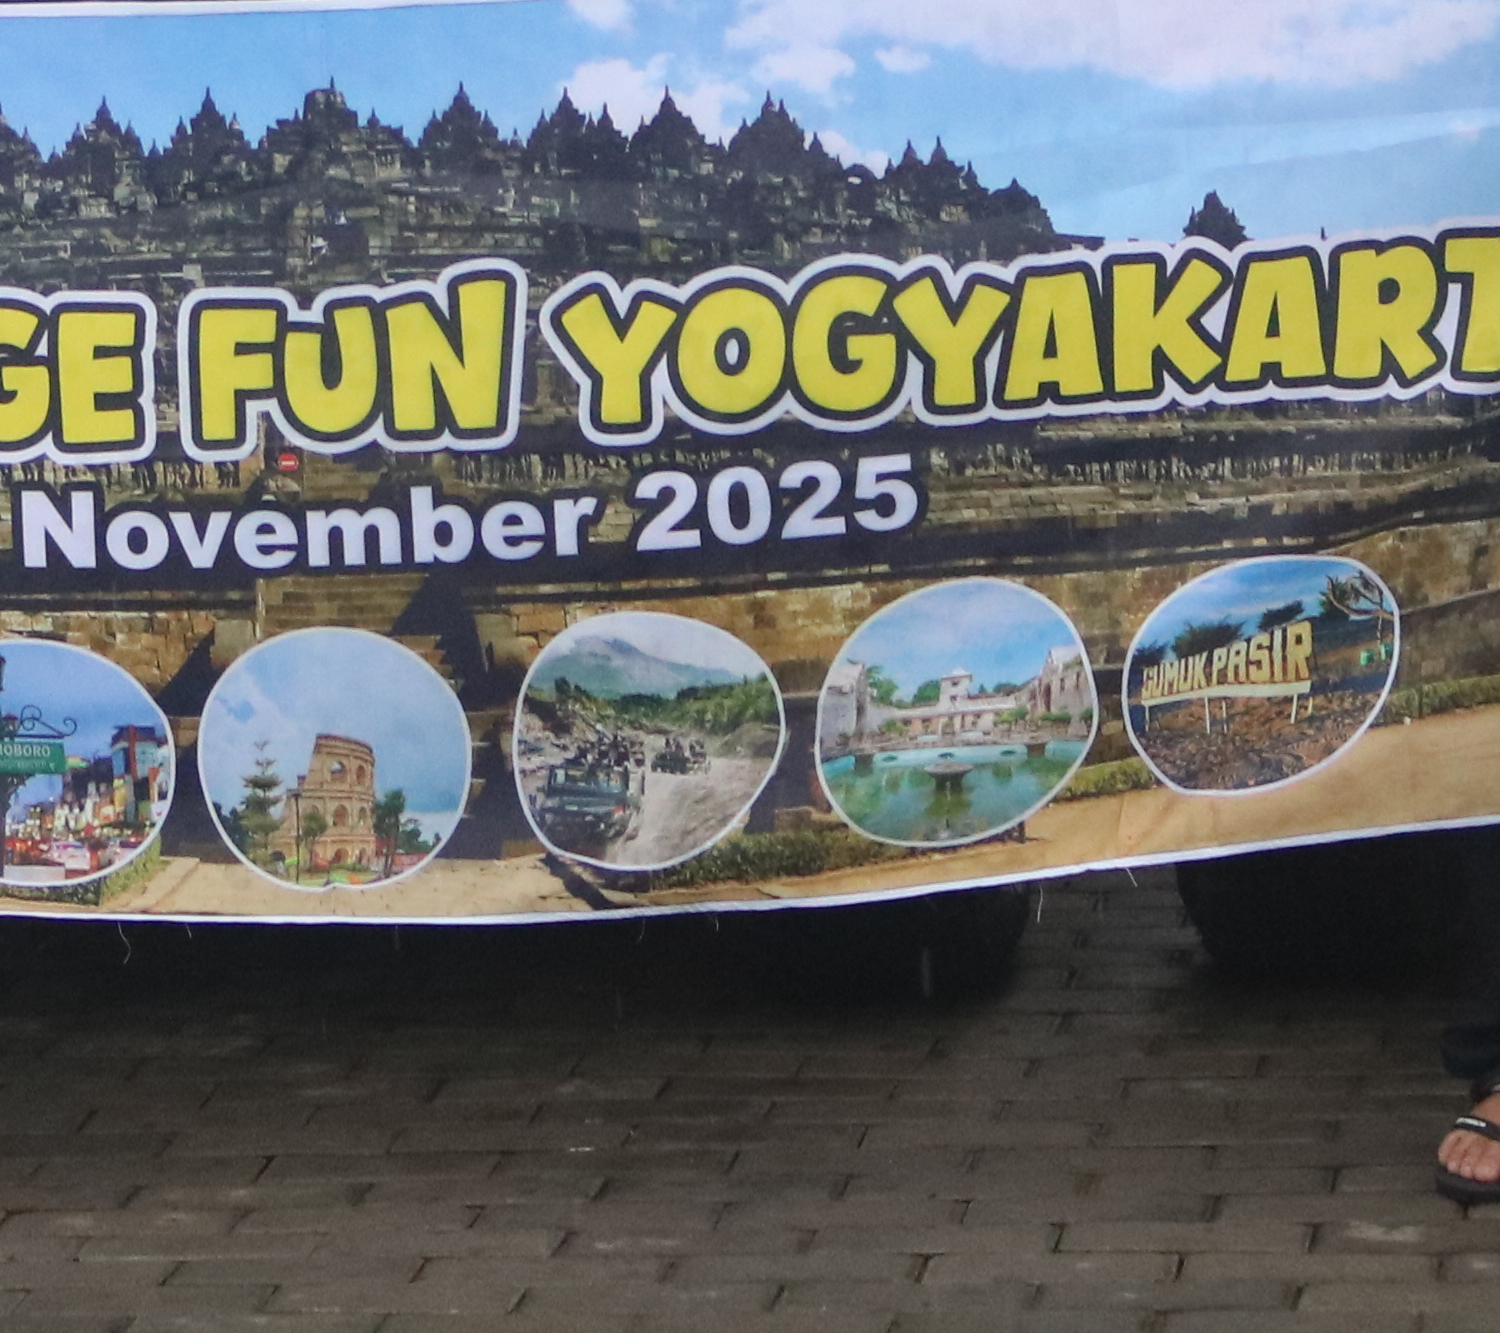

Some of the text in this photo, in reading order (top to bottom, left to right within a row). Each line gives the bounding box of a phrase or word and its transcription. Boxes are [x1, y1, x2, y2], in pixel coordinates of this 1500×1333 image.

[189, 277, 510, 445] FUN
[22, 481, 598, 567] November
[634, 455, 918, 551] 2025
[1142, 620, 1312, 700] GUMUK PASIR
